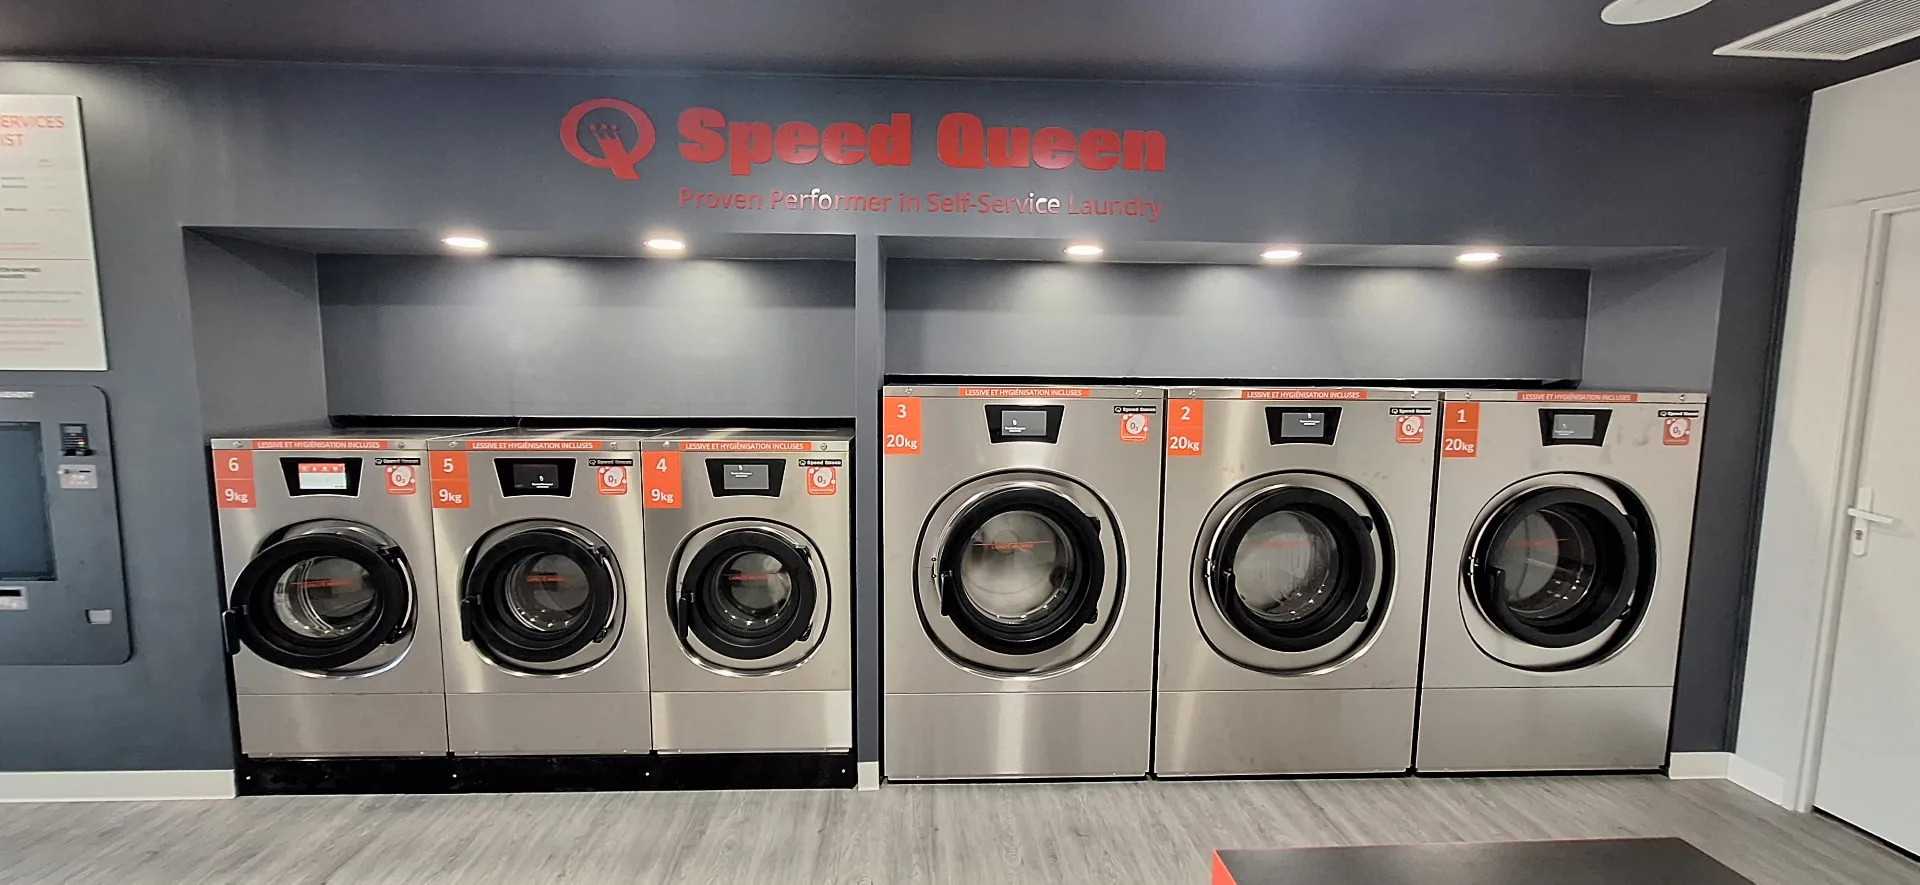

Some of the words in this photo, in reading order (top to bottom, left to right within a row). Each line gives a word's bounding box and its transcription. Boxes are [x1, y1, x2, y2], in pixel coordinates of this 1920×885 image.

[677, 107, 911, 176] Speed
[937, 112, 1166, 172] Queen
[678, 187, 762, 209] Proven
[769, 188, 888, 213] Performer
[899, 193, 920, 212] in
[927, 192, 1060, 215] Self-Service
[1068, 195, 1162, 222] Laundry
[897, 404, 907, 418] 3
[1180, 406, 1190, 420] 2
[1457, 409, 1466, 422] 1
[886, 434, 917, 450] 20kg
[1170, 436, 1200, 451] 20kg
[1445, 438, 1474, 453] 20kg
[228, 458, 239, 472] 6
[443, 458, 454, 472] 5
[656, 458, 668, 472] 4
[224, 489, 248, 503] 9kg
[439, 489, 462, 504] 9kg
[651, 489, 674, 504] 9kg
